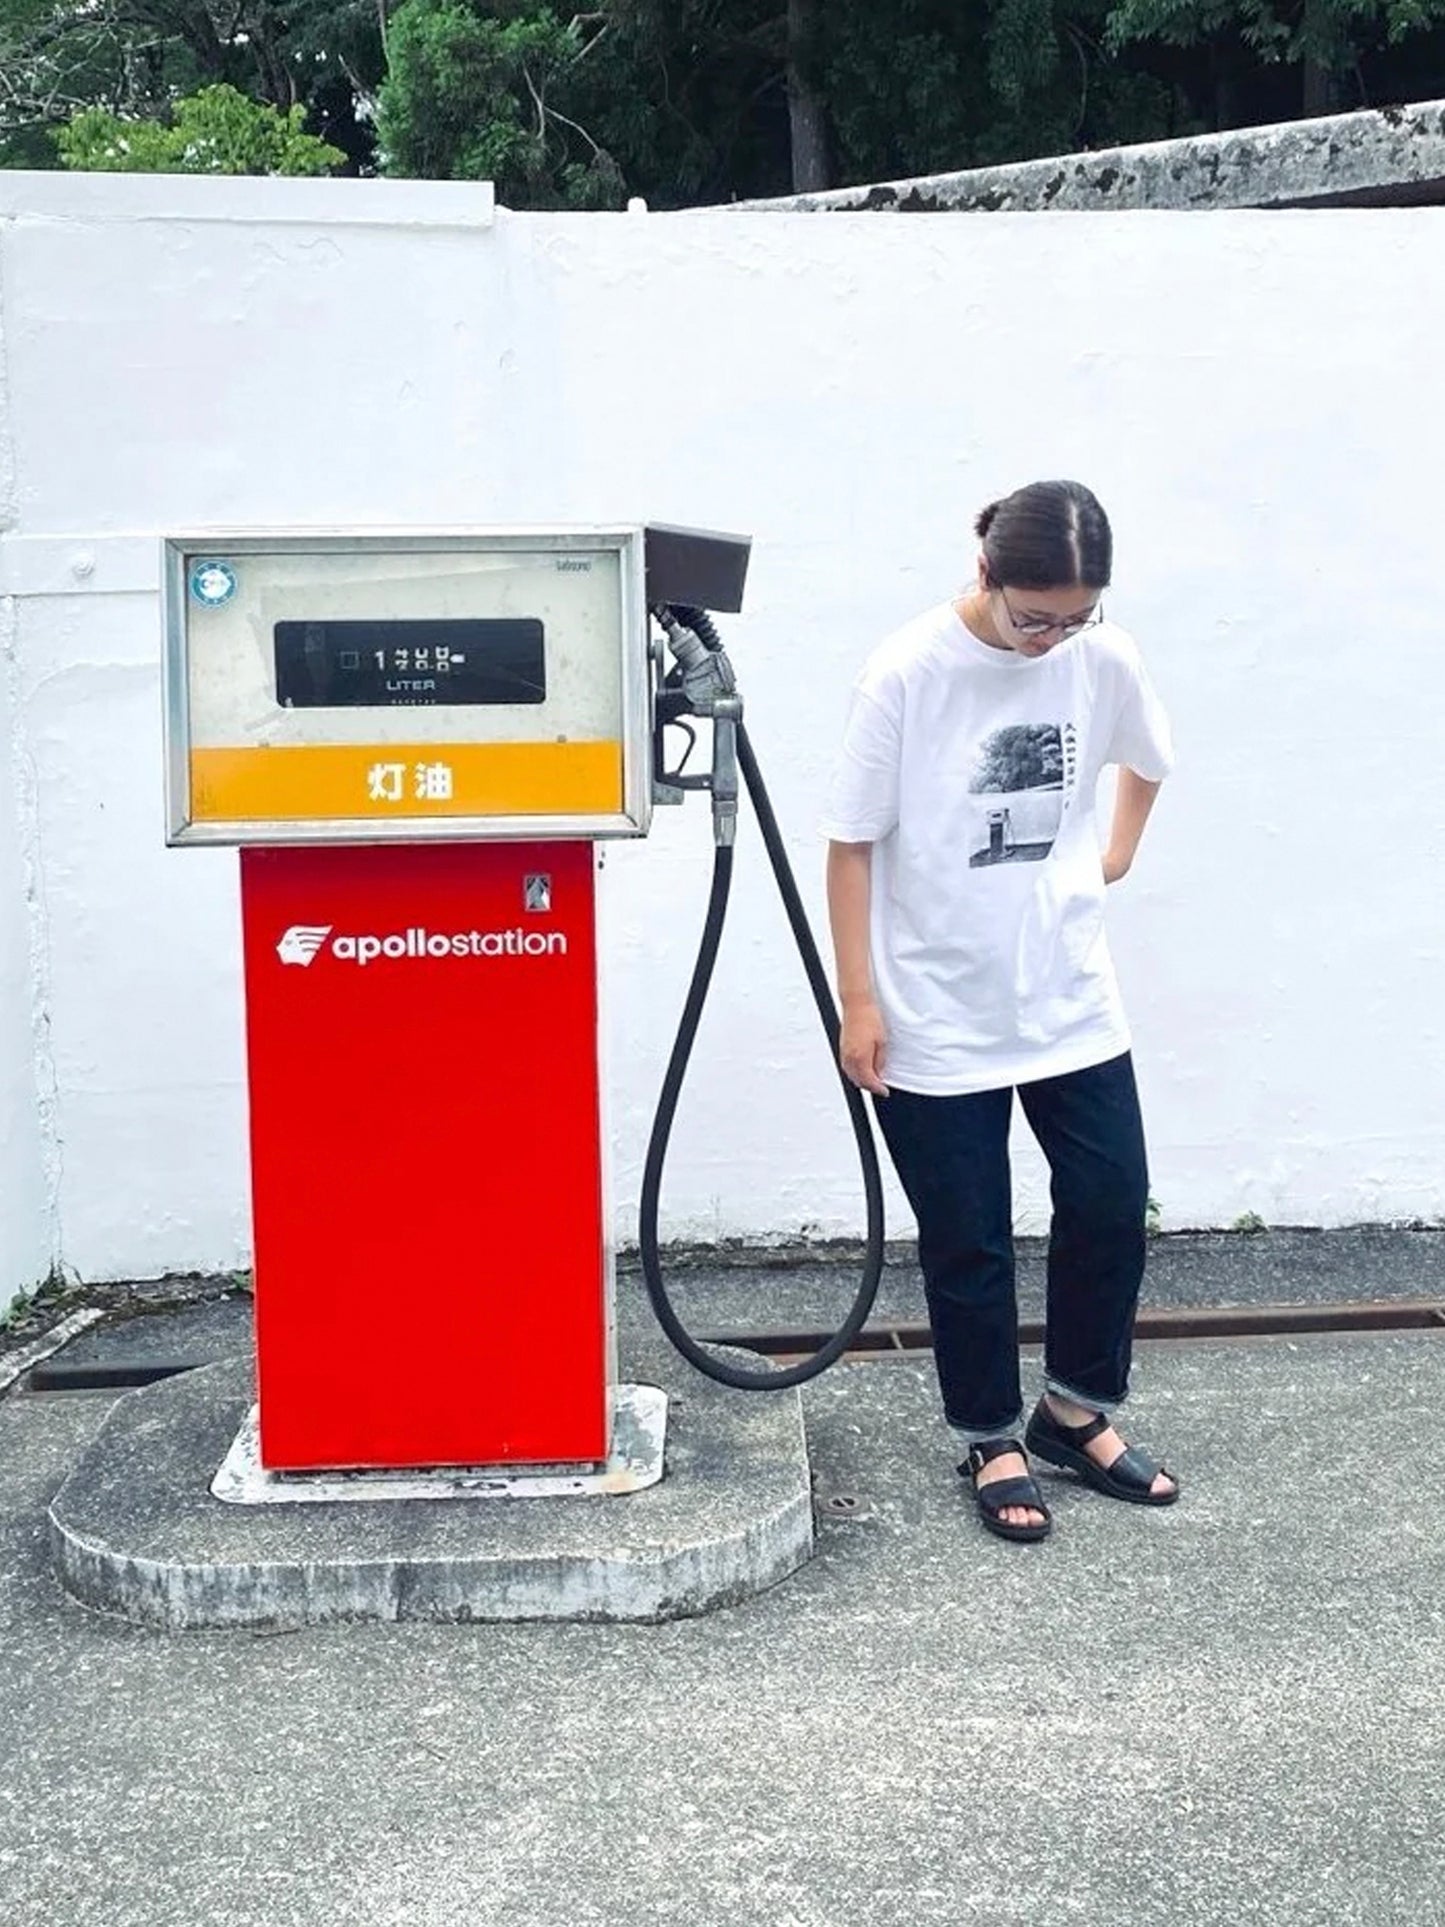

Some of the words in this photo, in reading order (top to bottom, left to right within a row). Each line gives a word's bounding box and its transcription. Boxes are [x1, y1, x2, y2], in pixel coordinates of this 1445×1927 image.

[386, 680, 436, 691] LITER
[367, 762, 453, 801] 灯油
[332, 927, 568, 966] apollostation
